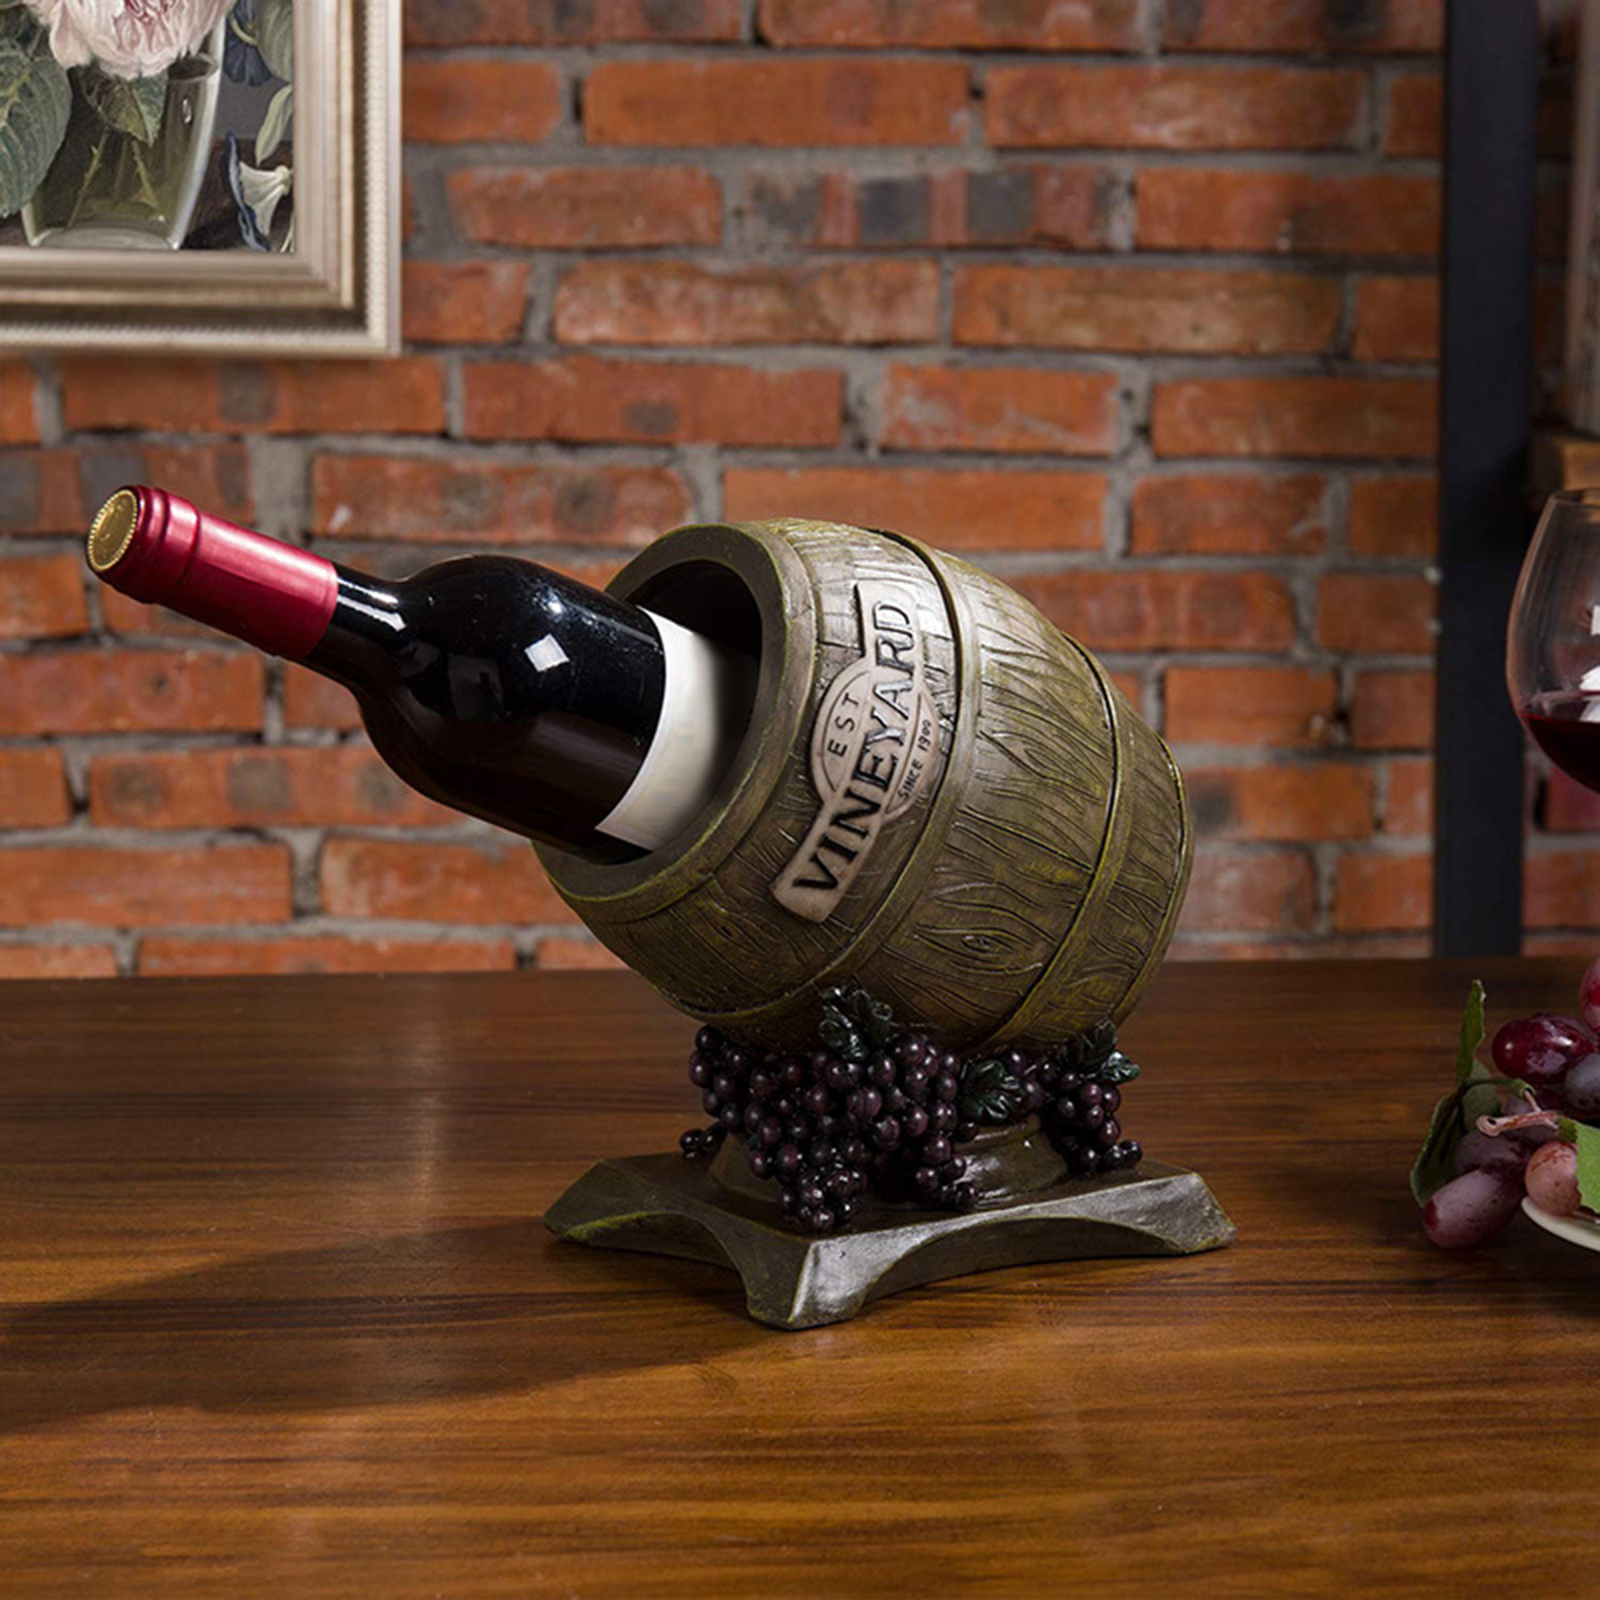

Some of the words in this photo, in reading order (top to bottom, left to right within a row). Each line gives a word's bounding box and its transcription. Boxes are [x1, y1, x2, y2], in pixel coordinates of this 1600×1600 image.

[792, 602, 916, 890] VINEYARD
[827, 692, 860, 758] EST
[898, 759, 923, 800] SINCE
